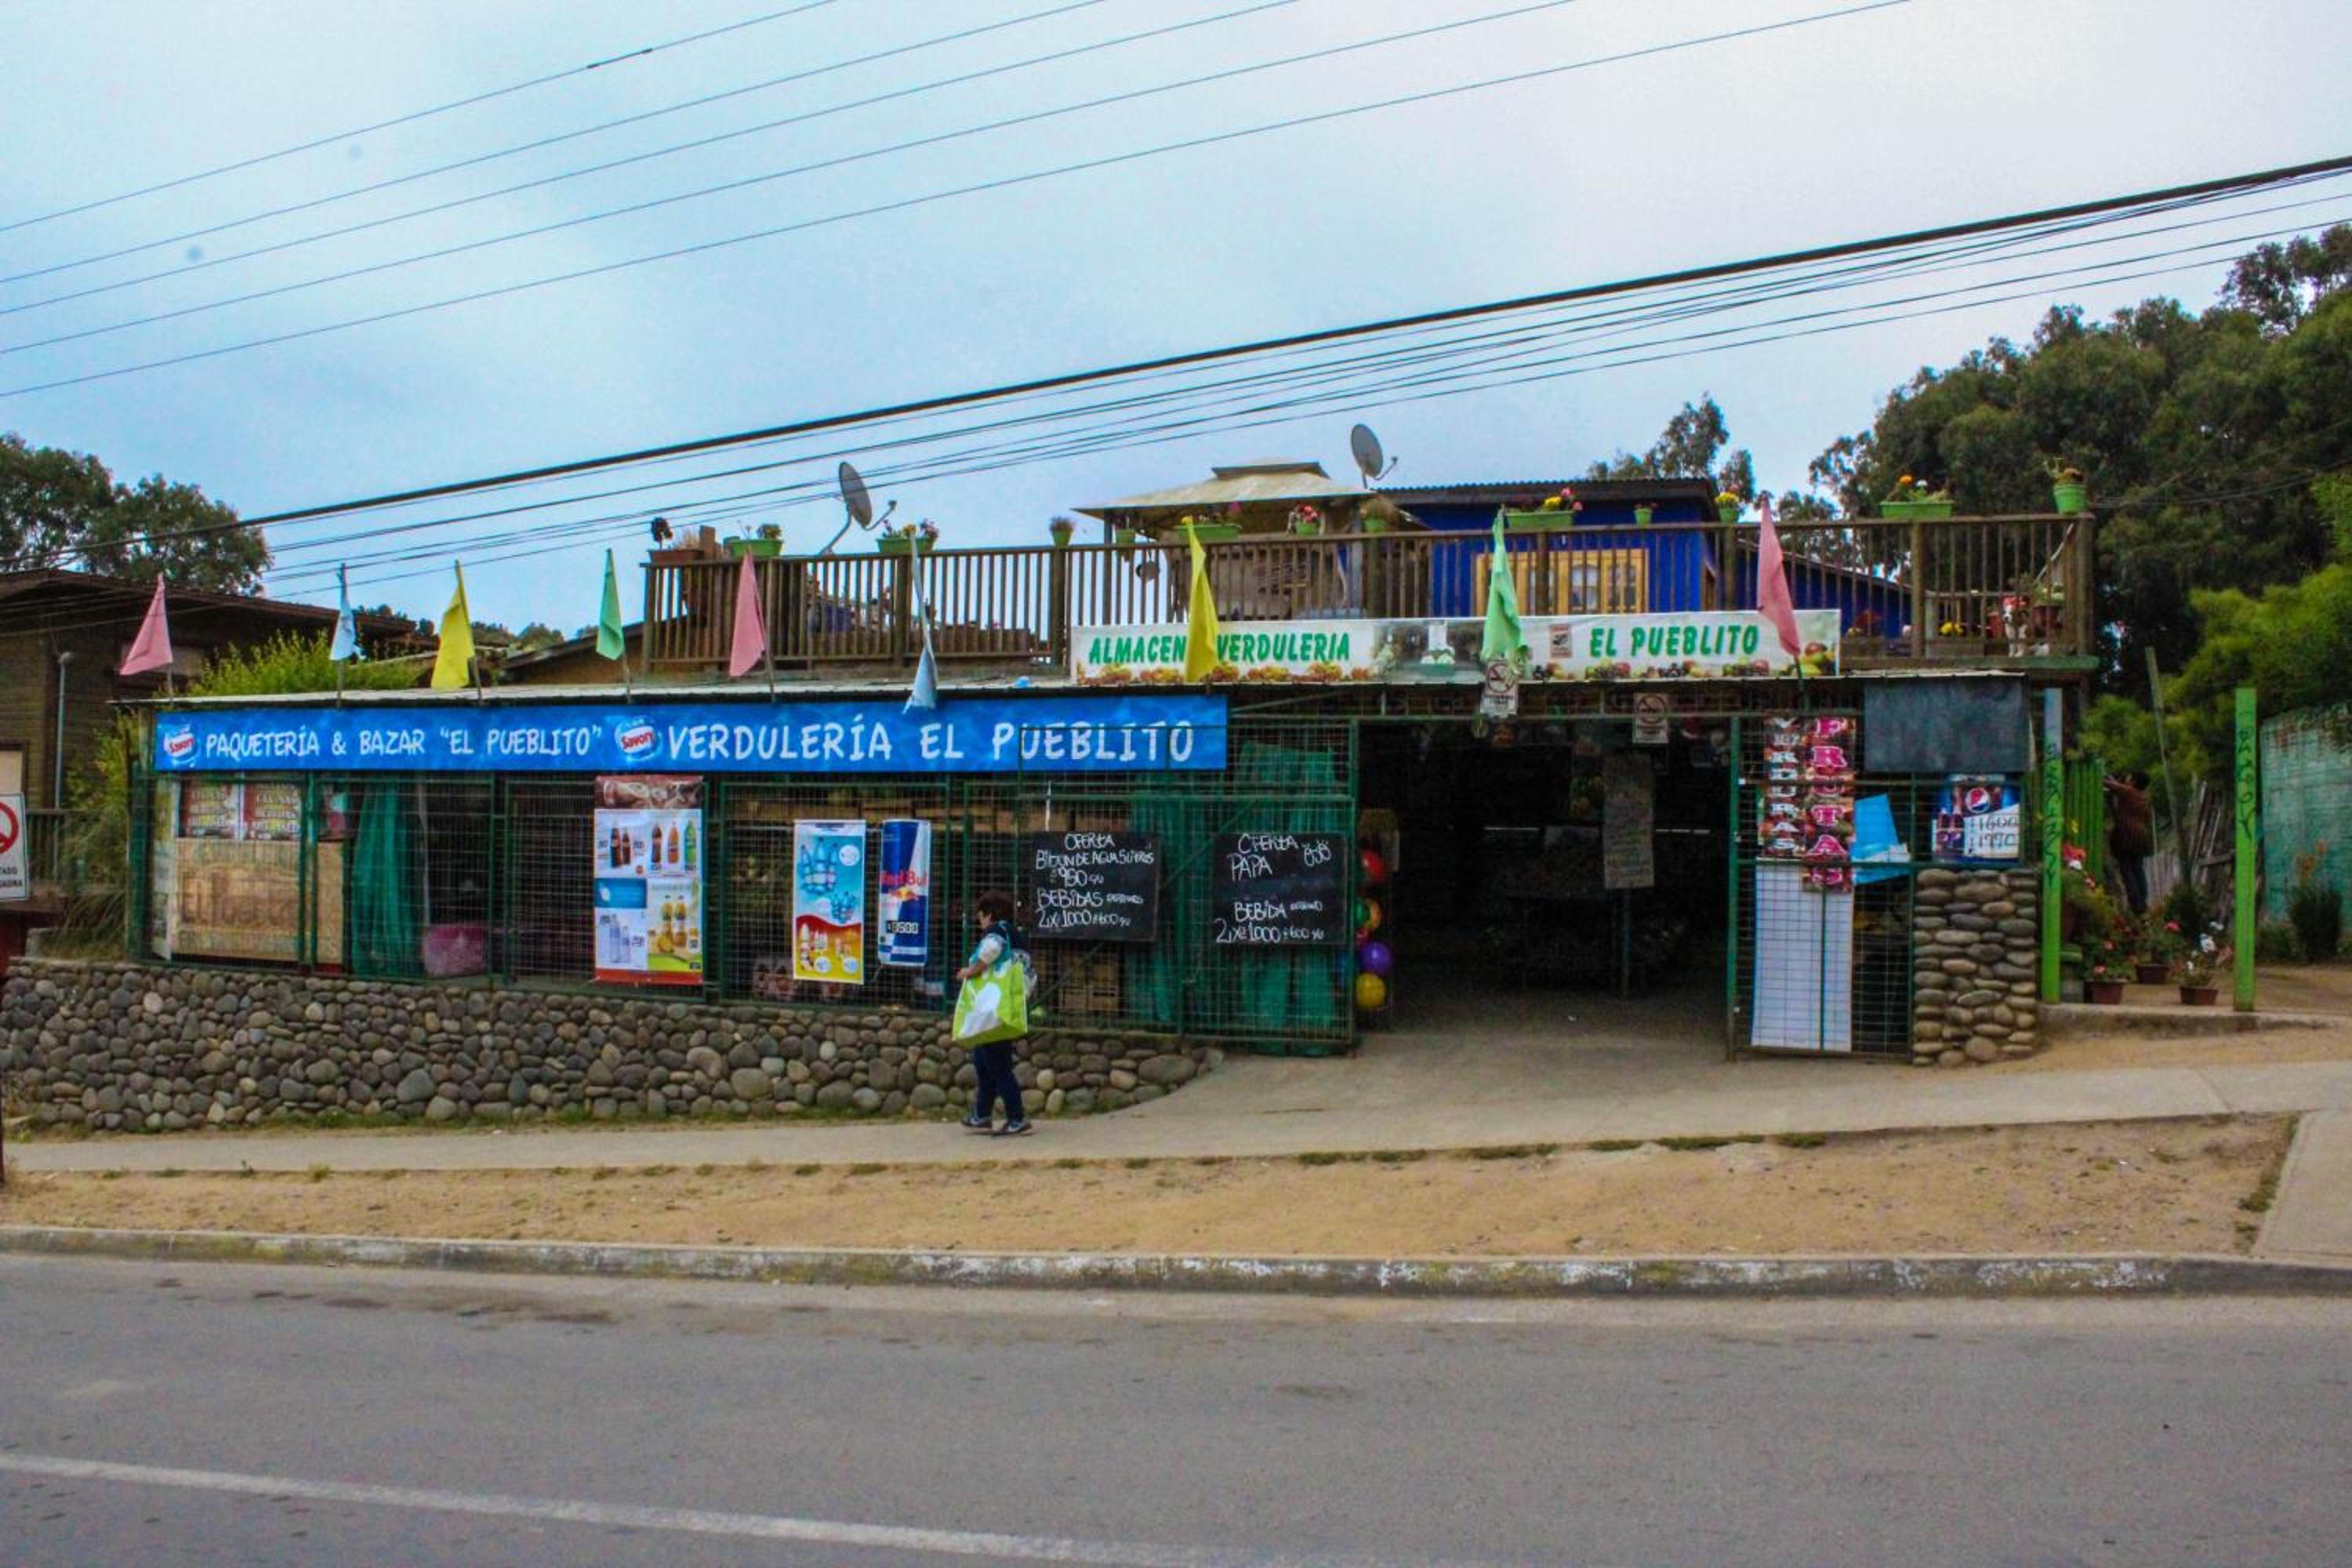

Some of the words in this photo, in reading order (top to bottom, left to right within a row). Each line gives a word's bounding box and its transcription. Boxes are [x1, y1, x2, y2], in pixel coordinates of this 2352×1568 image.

[1088, 635, 1186, 665] ALMACEN
[1215, 633, 1350, 663] VERDULERIA
[1590, 627, 1617, 657] EL
[1631, 625, 1759, 656] PUEBLITO
[205, 726, 319, 760] PAQUETERÍA
[332, 740, 347, 754] &
[360, 728, 425, 755] BAZAR
[668, 715, 891, 760] VERDULERÍA
[920, 724, 964, 760] EL
[993, 723, 1194, 762] PUEBLITO
[1227, 853, 1273, 881] PAPA
[1234, 901, 1288, 922] BEBIDA
